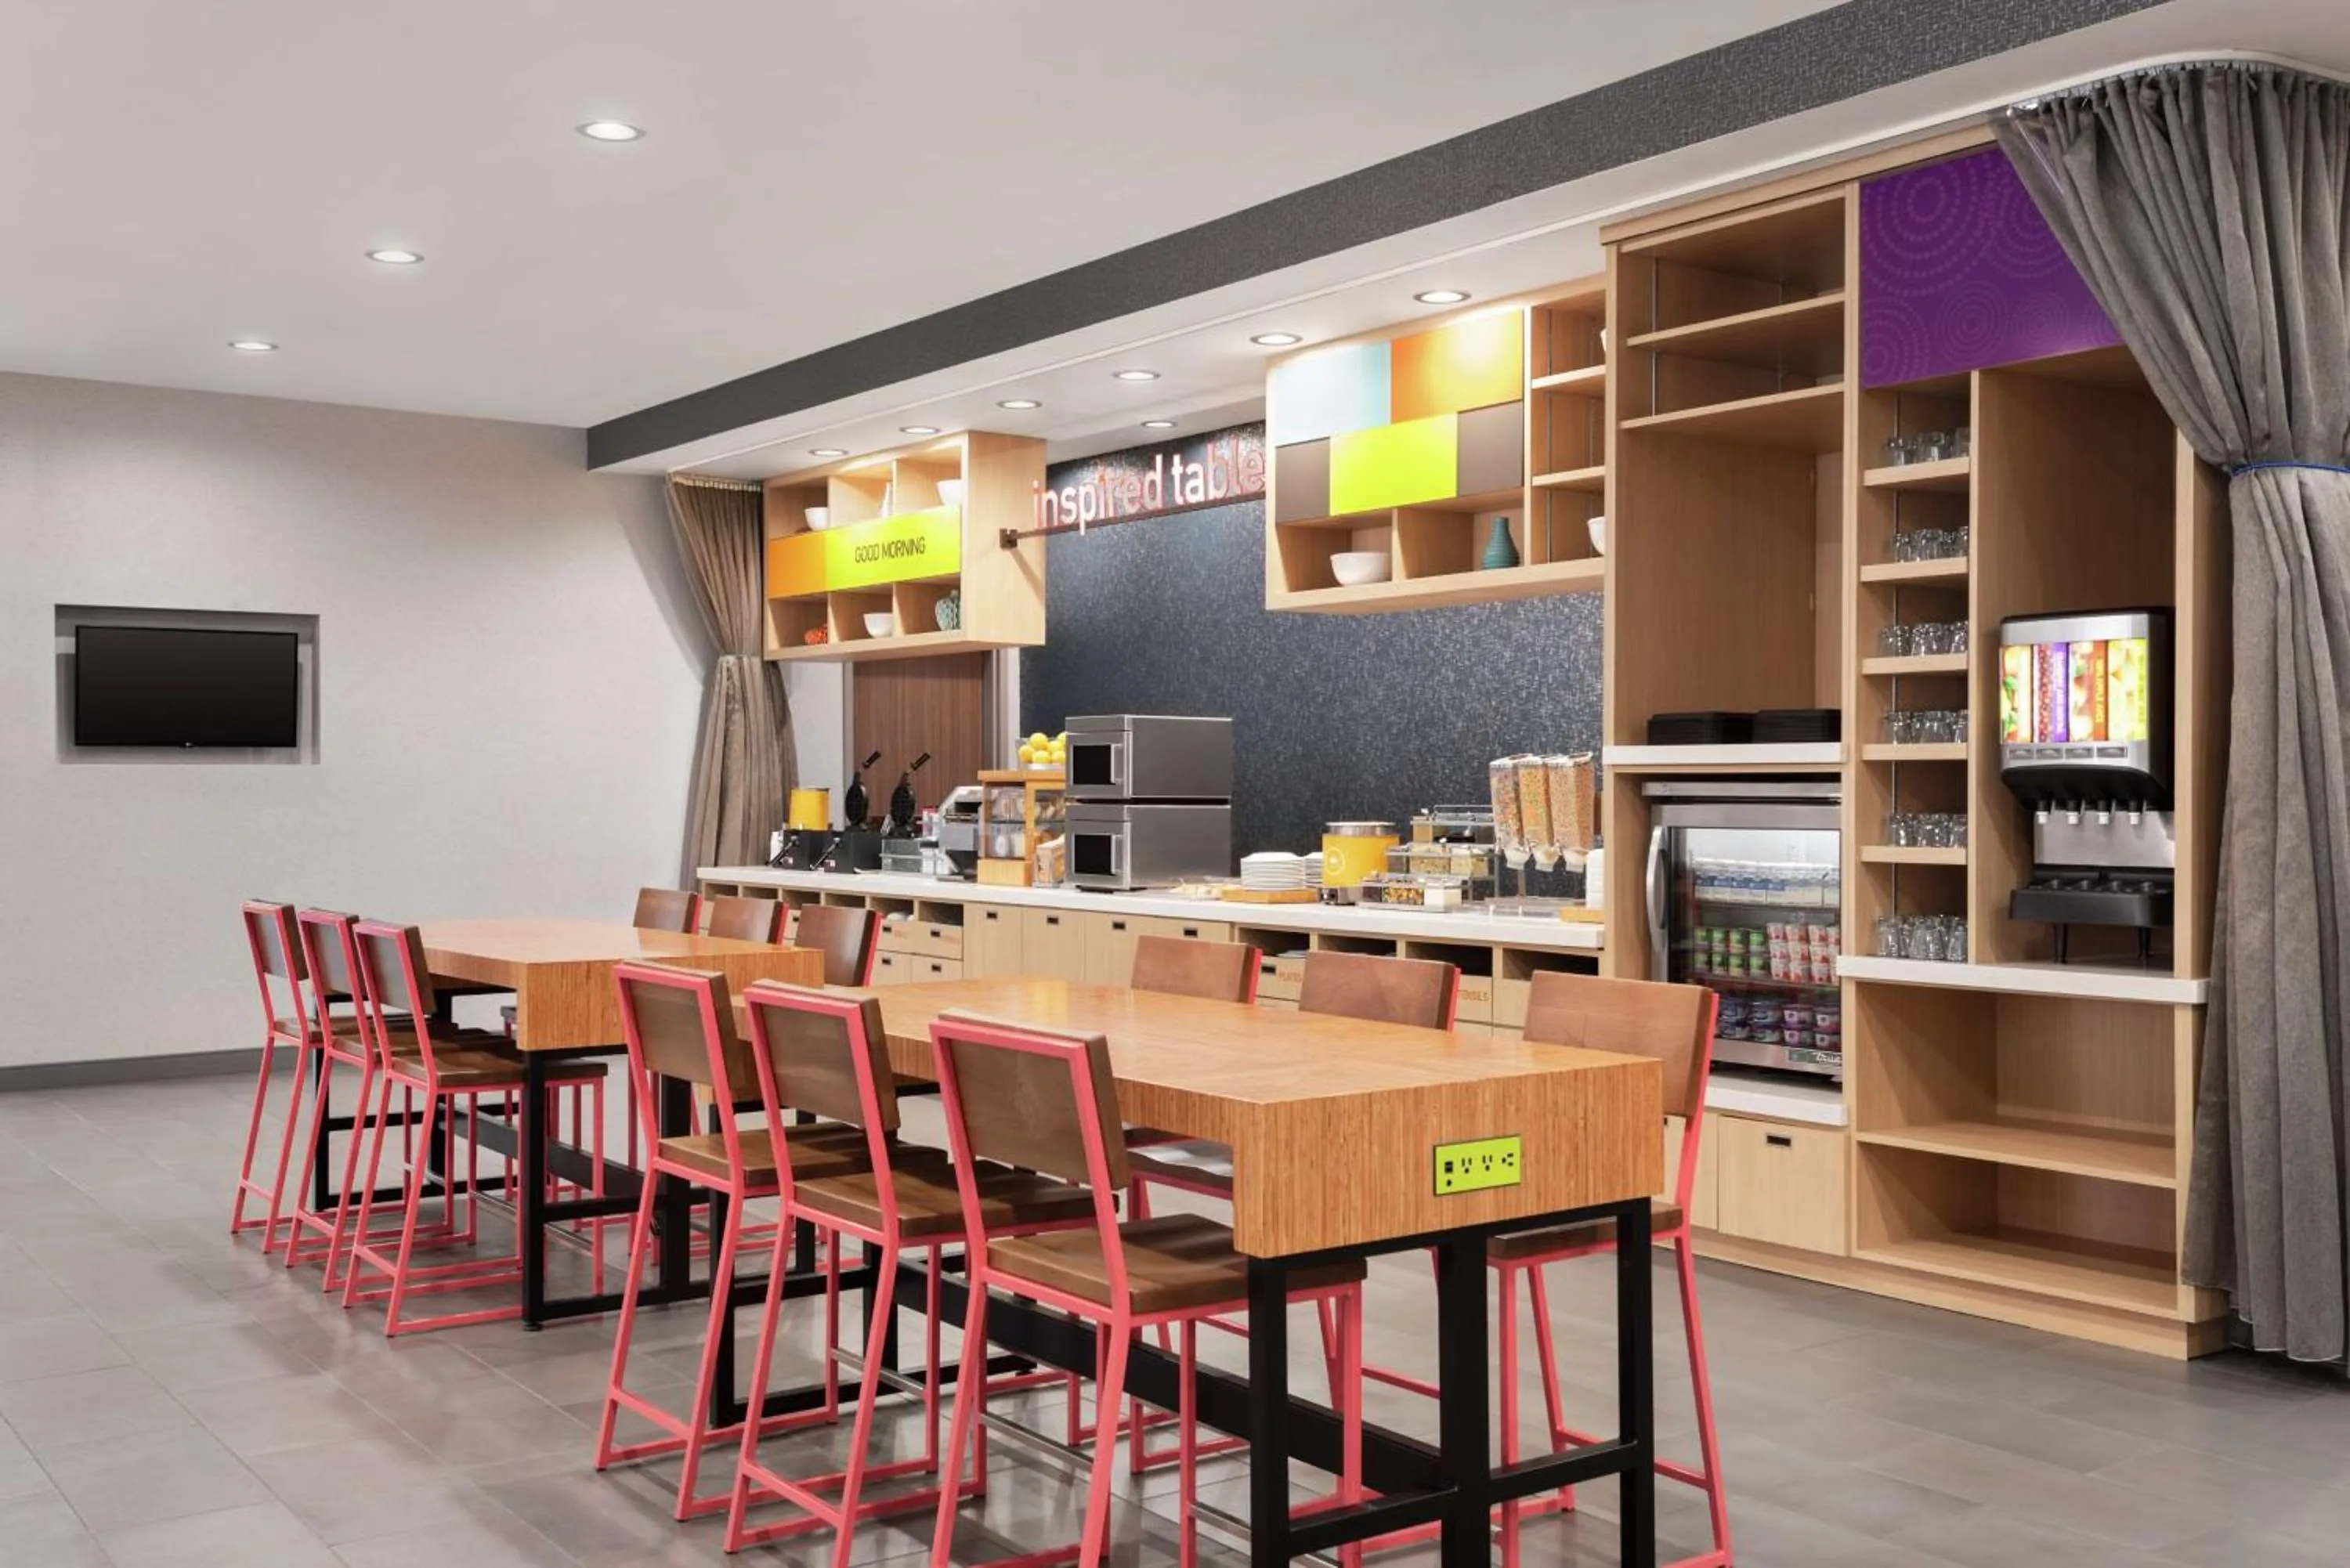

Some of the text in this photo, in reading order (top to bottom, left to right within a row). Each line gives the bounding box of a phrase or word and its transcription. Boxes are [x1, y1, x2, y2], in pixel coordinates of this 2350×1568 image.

[1032, 435, 1265, 536] inspired table
[855, 536, 926, 563] GOOD MORNING
